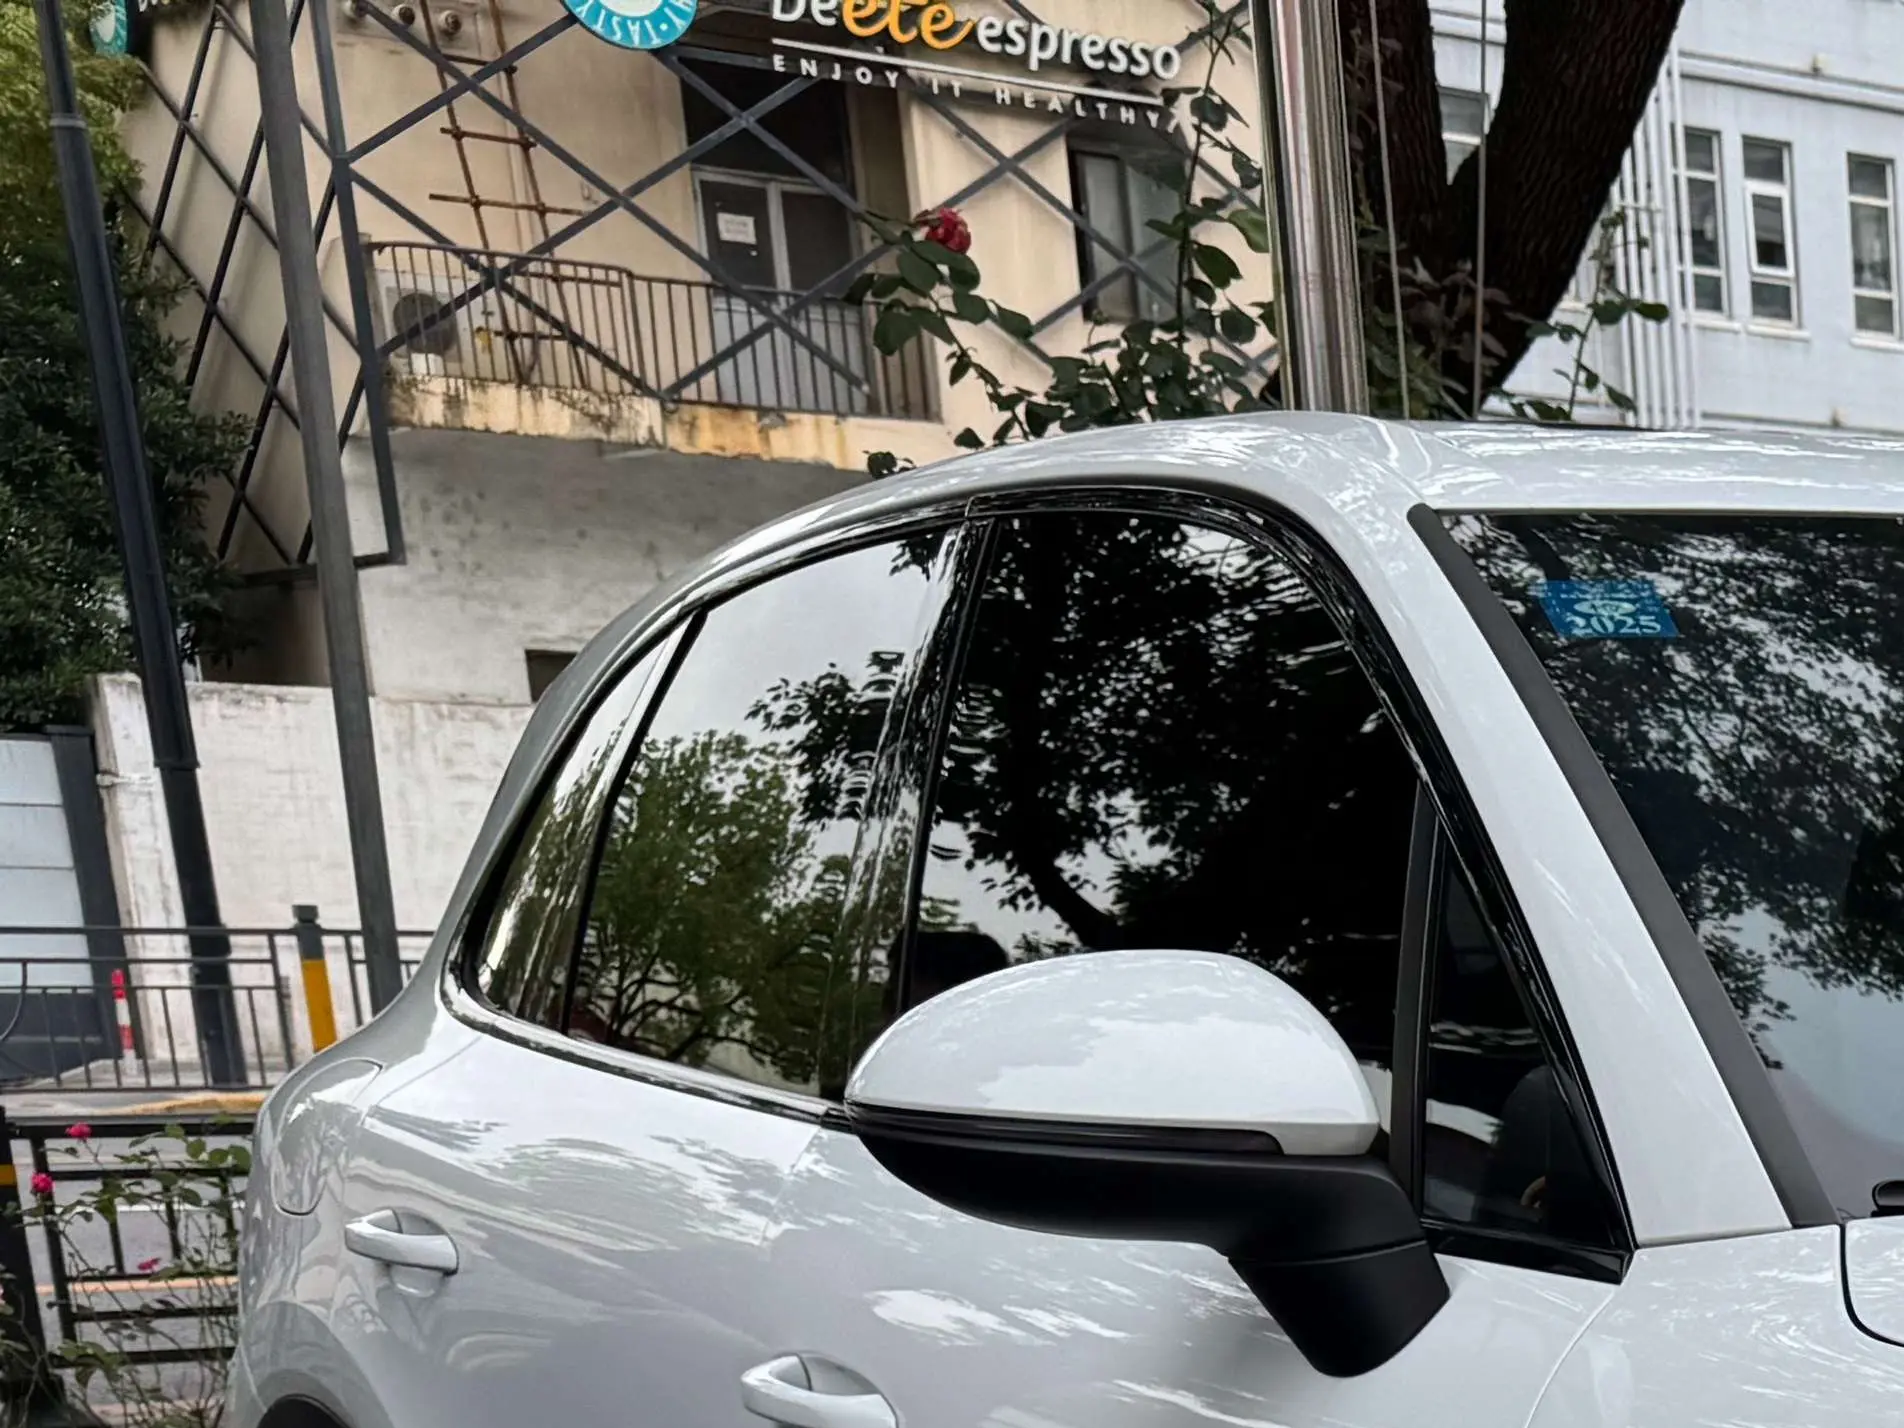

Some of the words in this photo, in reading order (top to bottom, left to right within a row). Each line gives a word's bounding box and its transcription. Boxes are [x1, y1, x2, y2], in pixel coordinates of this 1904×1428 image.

[976, 16, 1182, 80] espresso
[772, 54, 899, 89] ENJOY
[931, 78, 962, 98] IT
[994, 87, 1161, 129] HEALTHY
[1565, 614, 1662, 636] 2025
